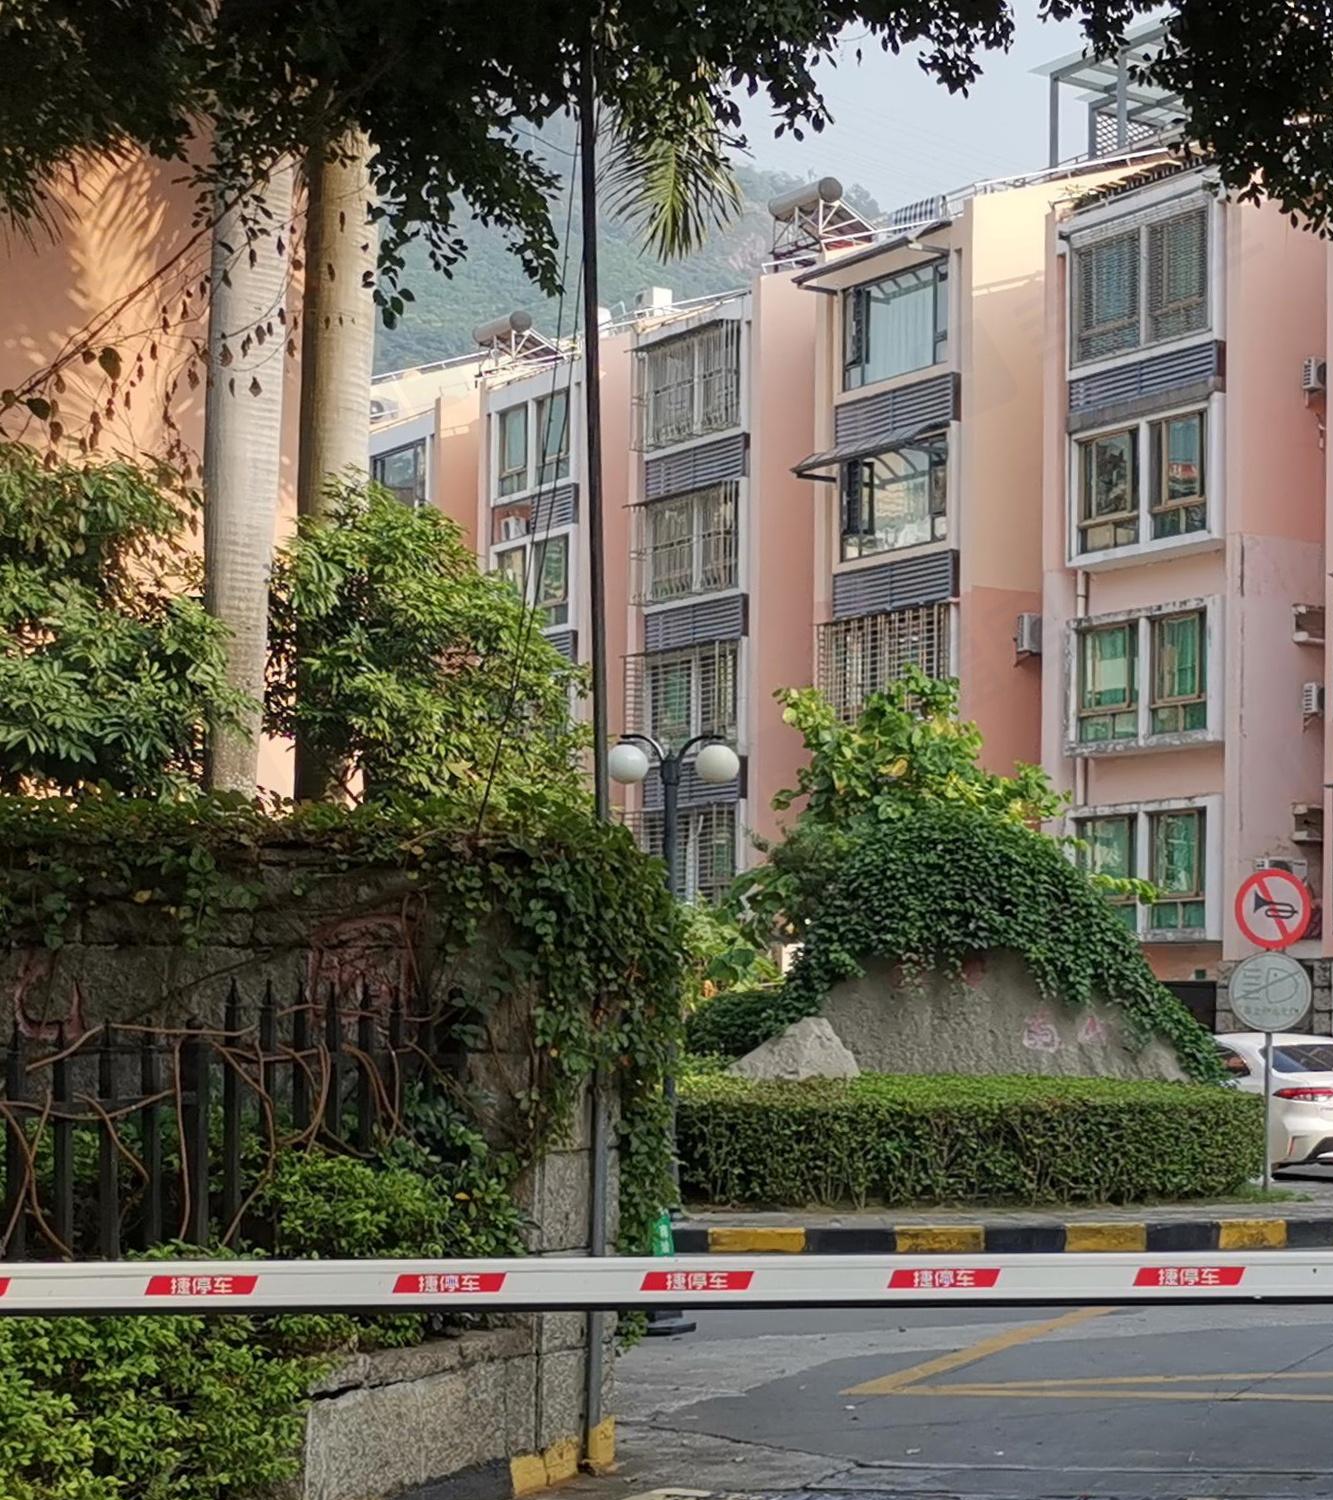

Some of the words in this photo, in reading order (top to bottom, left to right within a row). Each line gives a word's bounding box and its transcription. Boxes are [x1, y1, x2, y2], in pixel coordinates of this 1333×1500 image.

[170, 1276, 233, 1296] 捷停车
[418, 1273, 481, 1294] 捷停车
[666, 1271, 728, 1292] 捷停车
[913, 1268, 976, 1289] 捷停车
[1158, 1267, 1220, 1287] 捷停车
